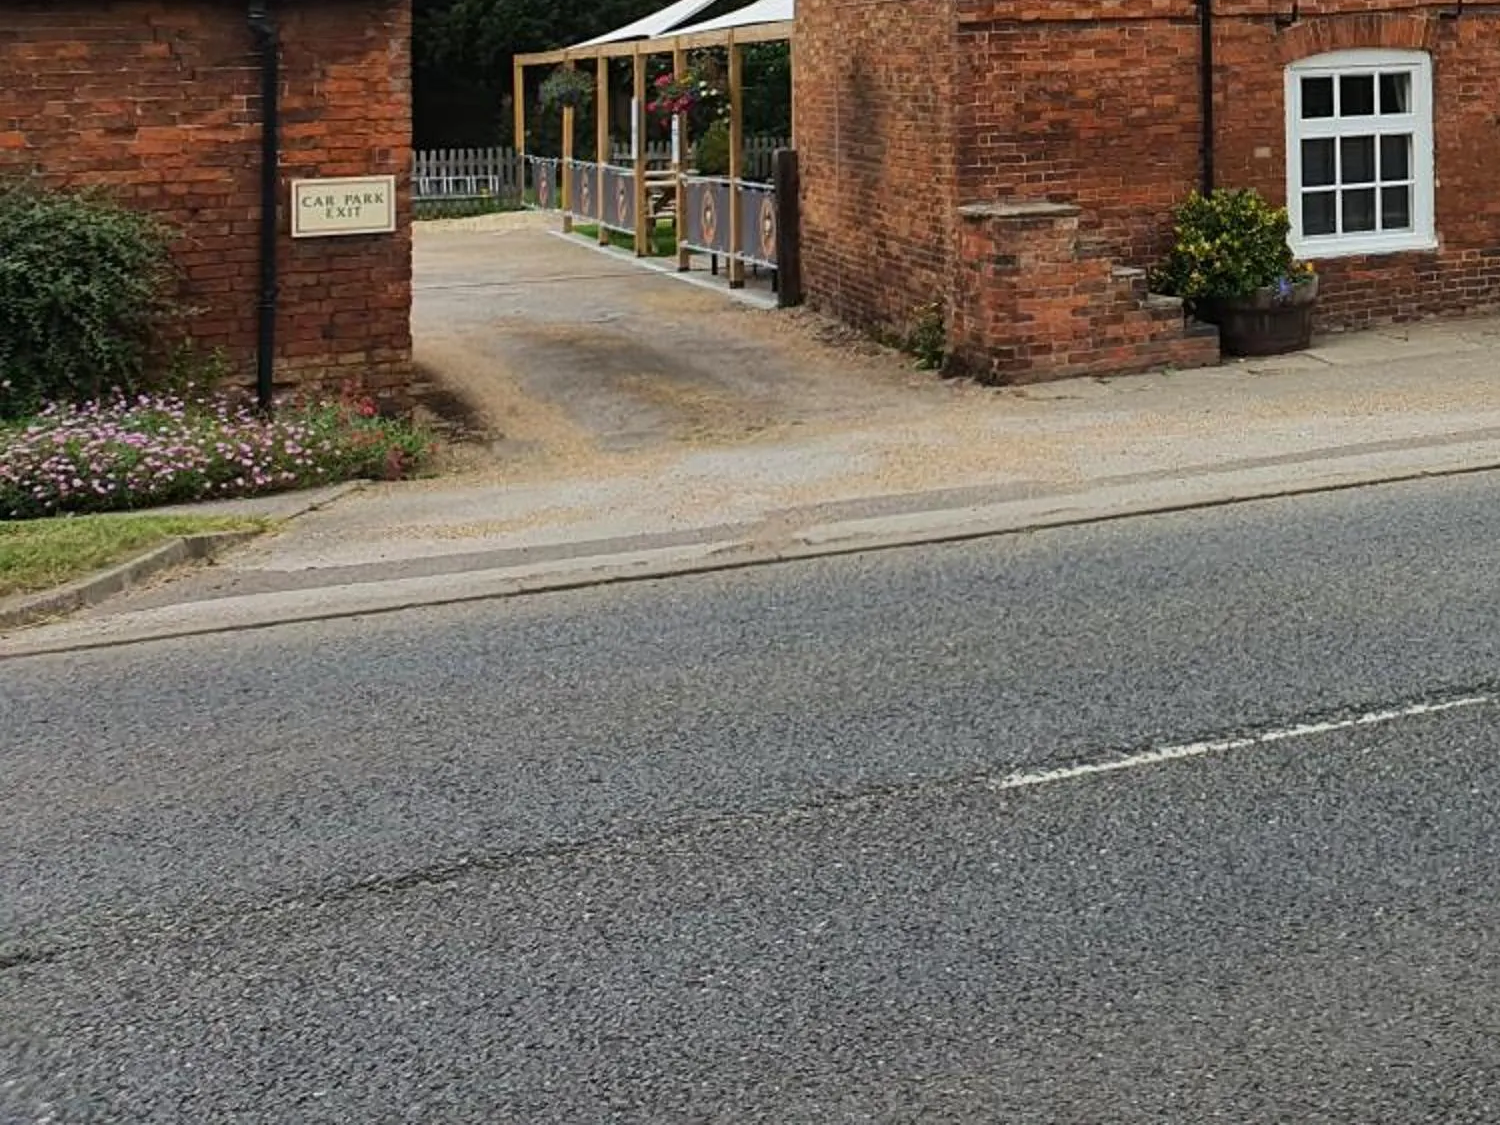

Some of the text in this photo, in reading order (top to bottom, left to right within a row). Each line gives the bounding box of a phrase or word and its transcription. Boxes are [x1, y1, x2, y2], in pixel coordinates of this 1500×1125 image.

[302, 193, 384, 208] CAR PARK
[326, 206, 361, 219] EXIT
